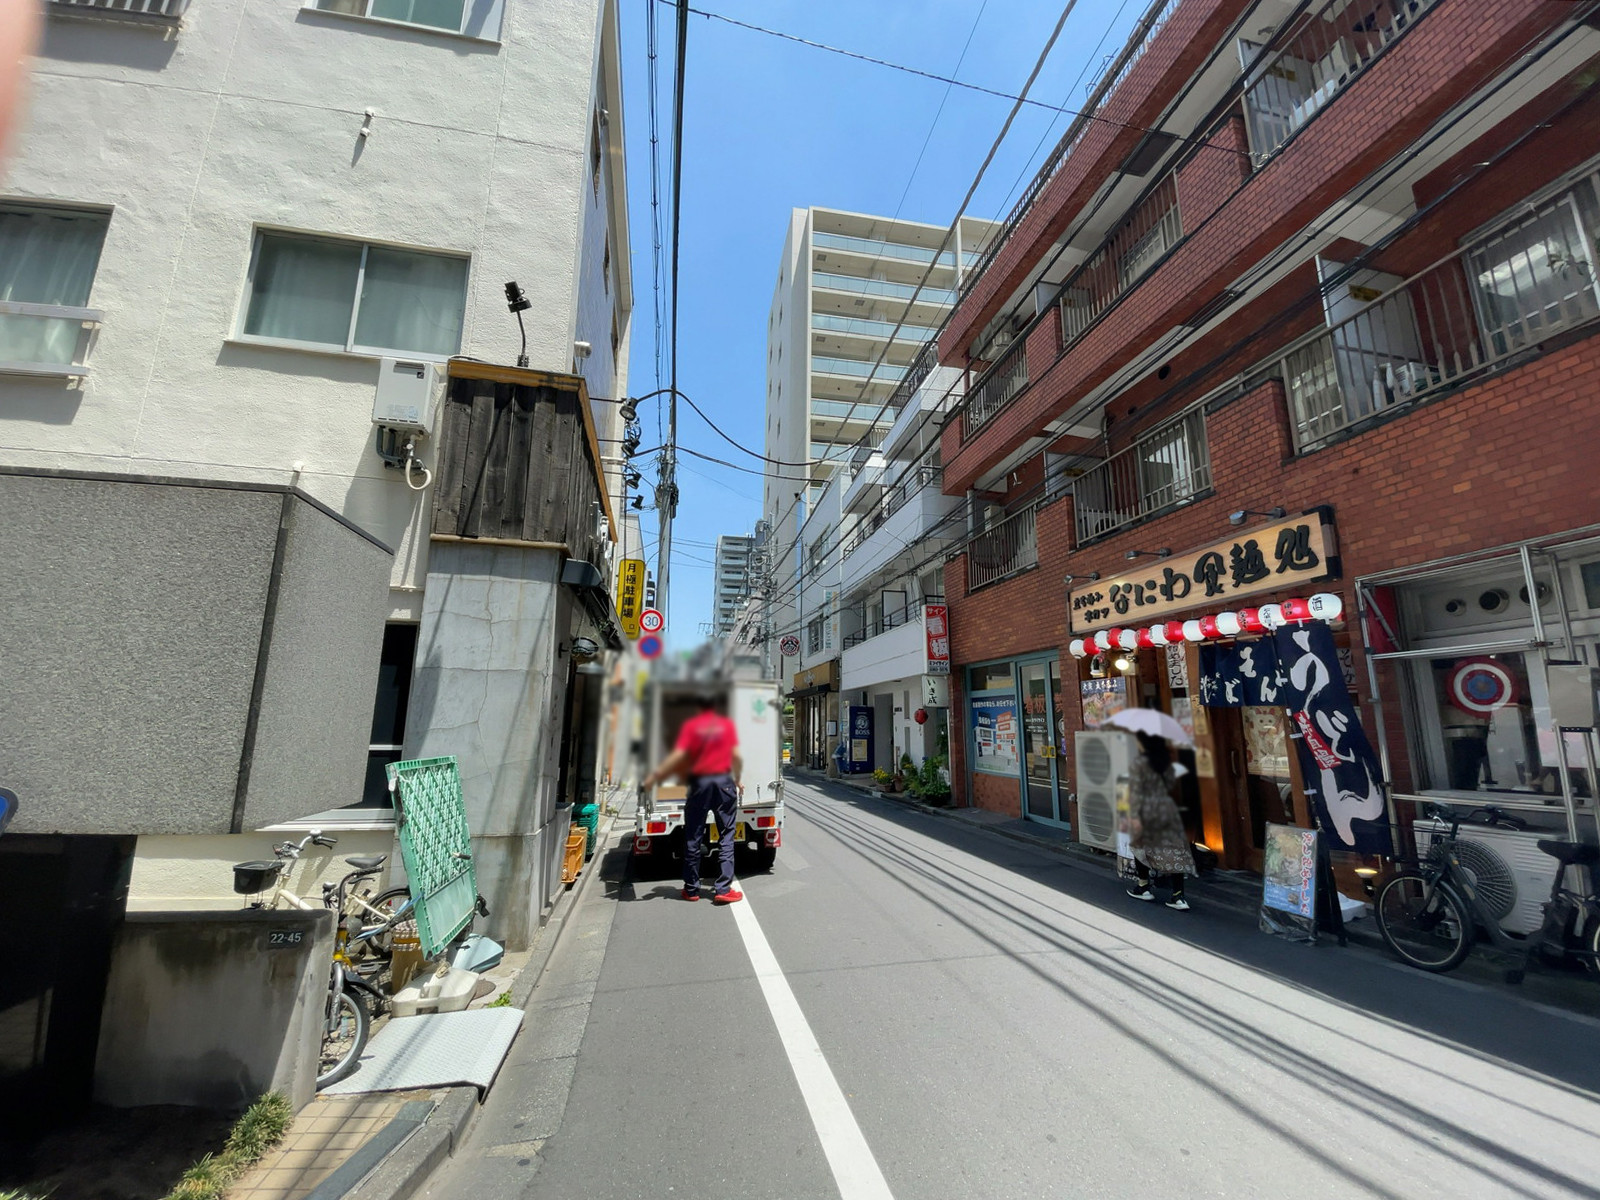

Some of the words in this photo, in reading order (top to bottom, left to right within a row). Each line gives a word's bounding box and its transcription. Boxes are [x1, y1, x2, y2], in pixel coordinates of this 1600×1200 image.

[622, 563, 636, 619] 月極駐車場
[927, 607, 947, 615] サイン
[645, 616, 659, 627] 30
[270, 932, 302, 944] 22-45
